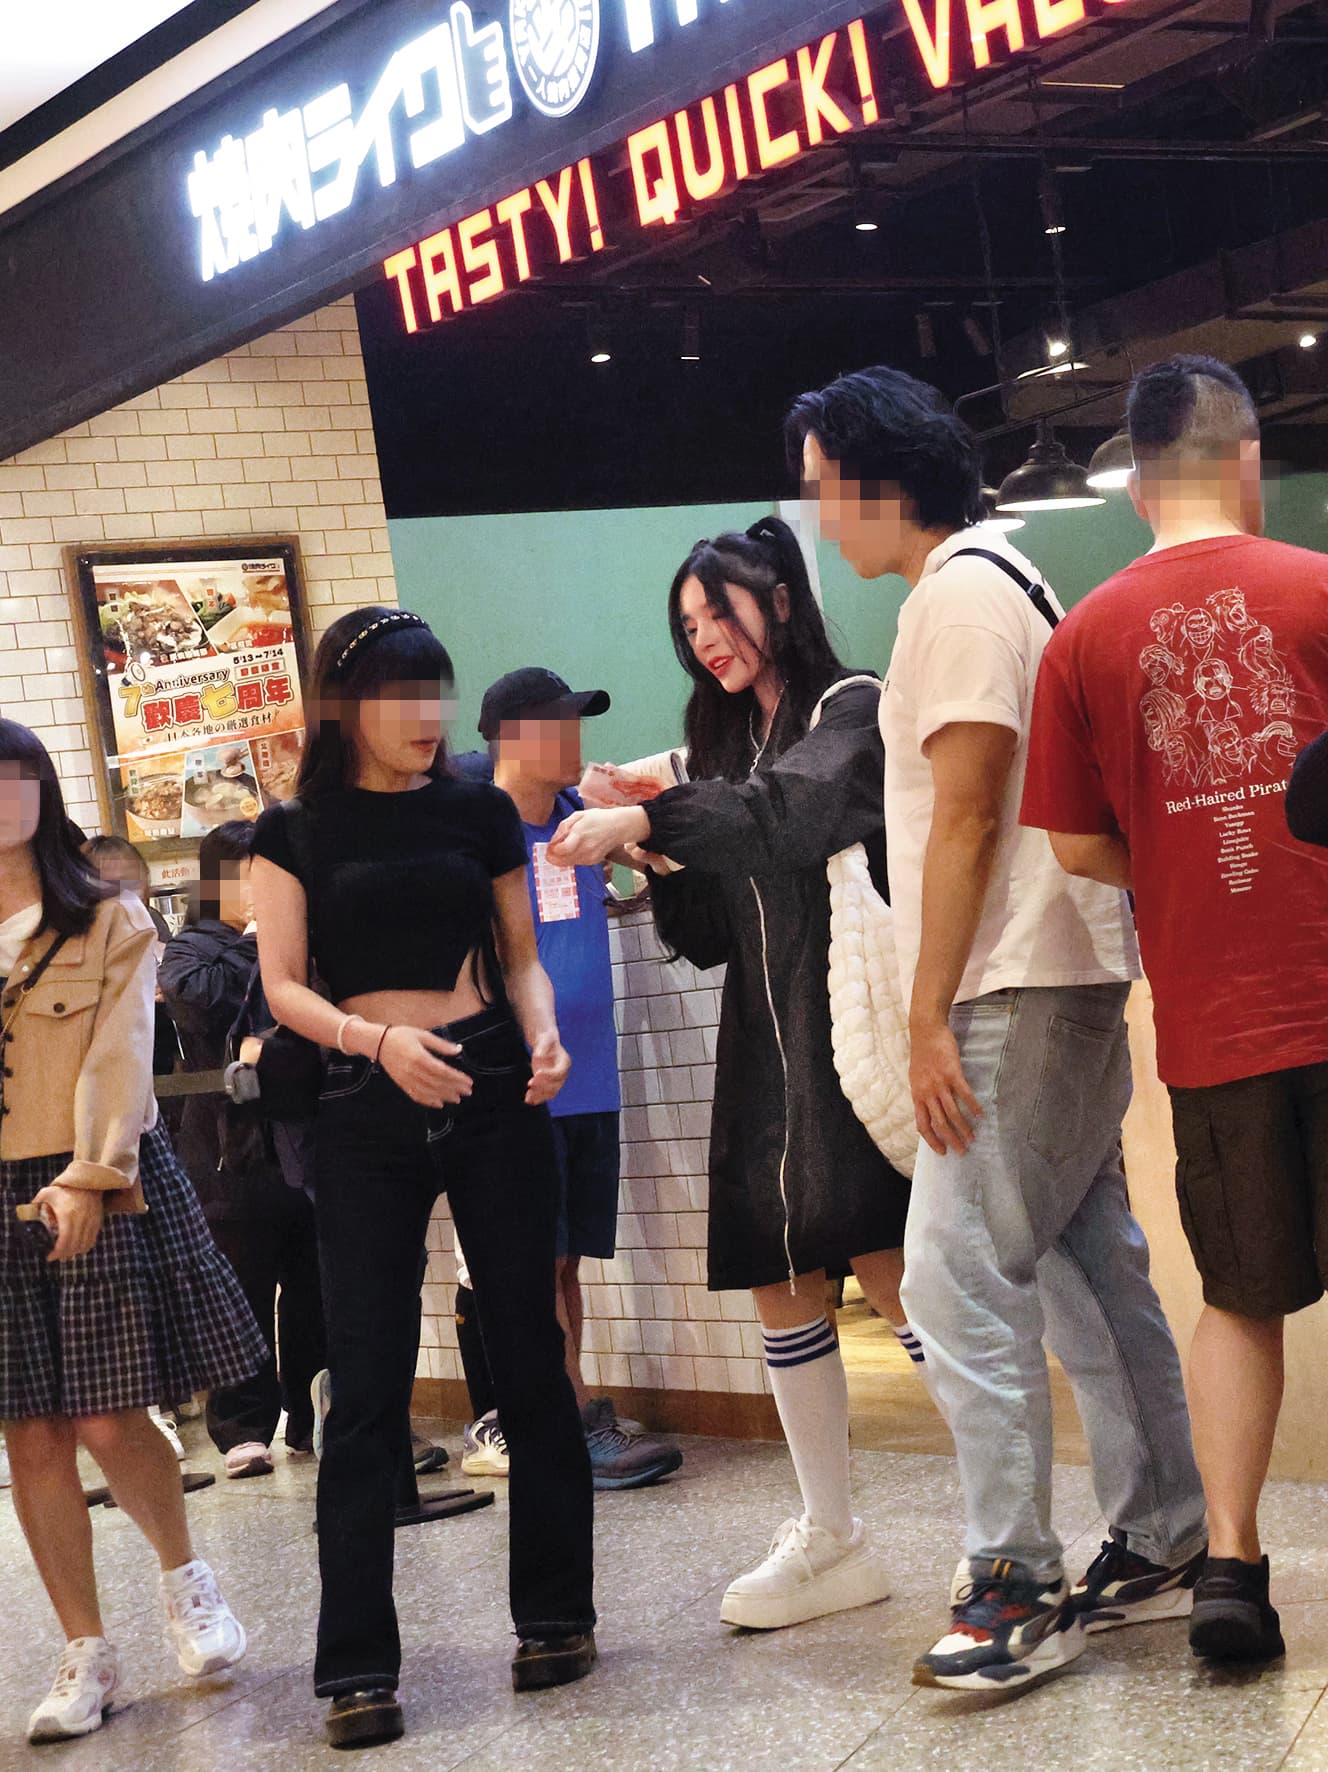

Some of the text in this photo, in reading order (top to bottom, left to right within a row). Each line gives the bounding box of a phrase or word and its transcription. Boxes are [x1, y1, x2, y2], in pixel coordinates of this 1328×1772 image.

[383, 156, 604, 334] TASTY!
[626, 19, 879, 228] QUICK!
[903, 0, 1127, 89] VA
[155, 669, 229, 692] Anniversary
[143, 676, 291, 731] 歡慶七周年
[1165, 779, 1289, 814] Red-Haired Pirat
